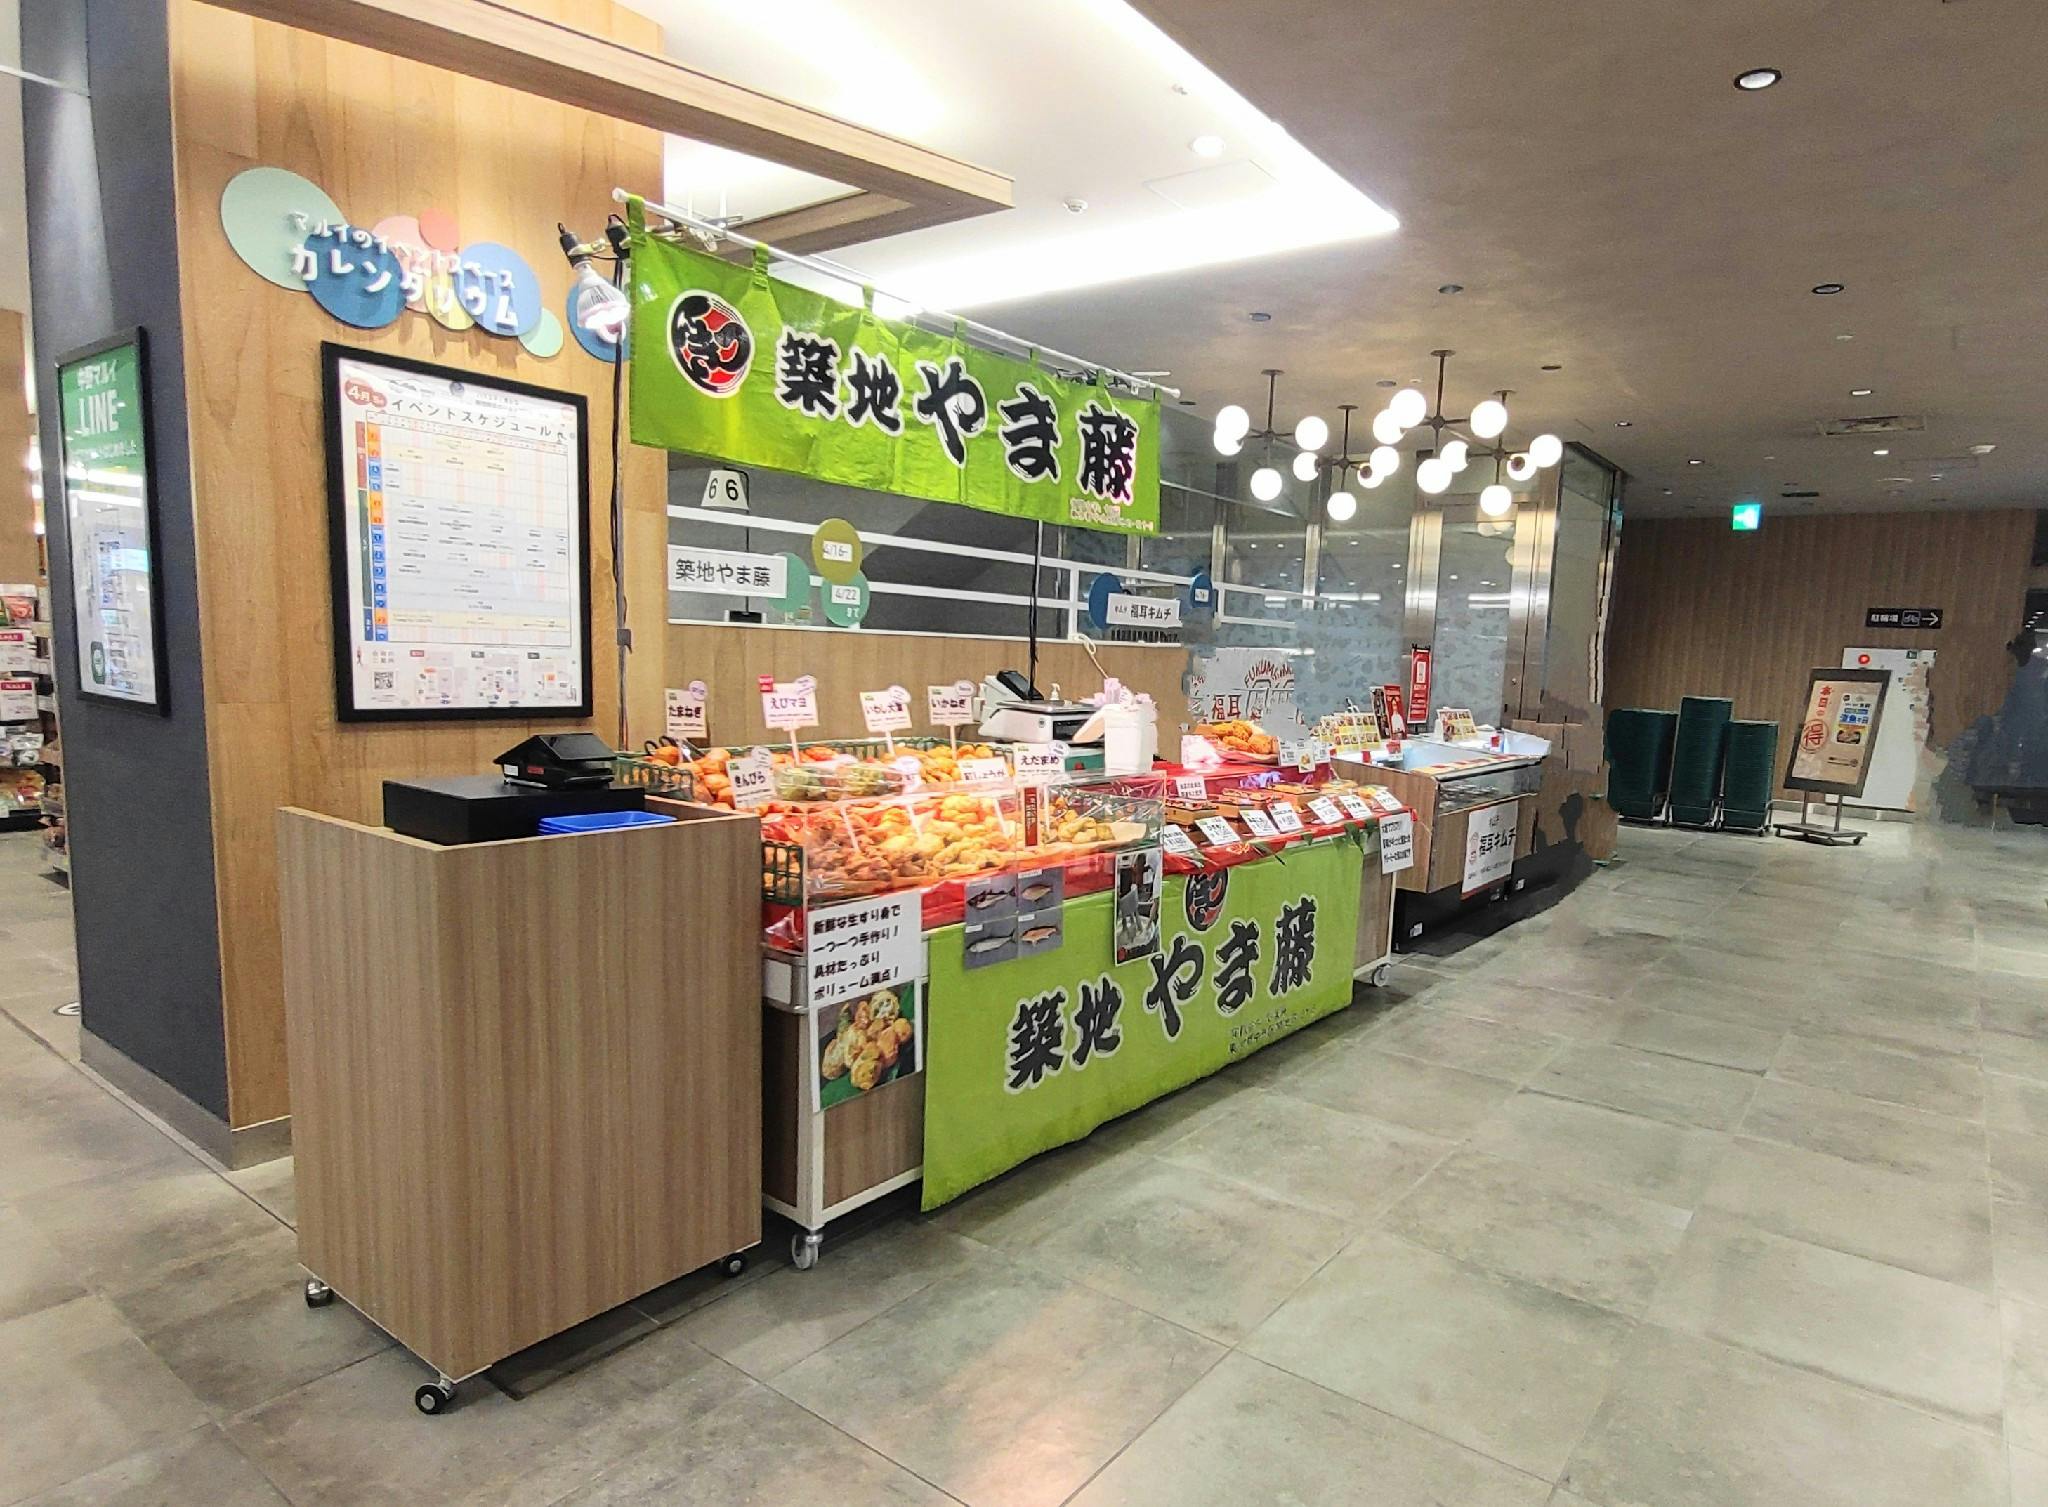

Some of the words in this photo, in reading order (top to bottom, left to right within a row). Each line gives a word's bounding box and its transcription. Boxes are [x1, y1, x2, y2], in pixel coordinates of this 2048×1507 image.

[291, 243, 519, 327] カレンダリウム
[78, 388, 119, 436] LINE
[391, 398, 552, 437] イベントスケジュール
[775, 329, 1138, 504] 築地やま藤
[675, 558, 771, 588] 築地やま藤
[668, 706, 702, 719] たまねぎ
[770, 697, 808, 709] えびマヨ
[1020, 755, 1060, 766] えだまめ
[734, 770, 766, 788] きんぴら
[813, 904, 901, 935] 新鮮な生すり身で
[814, 951, 880, 979] 具材たっぷり
[1004, 897, 1318, 1090] 築地やま藤
